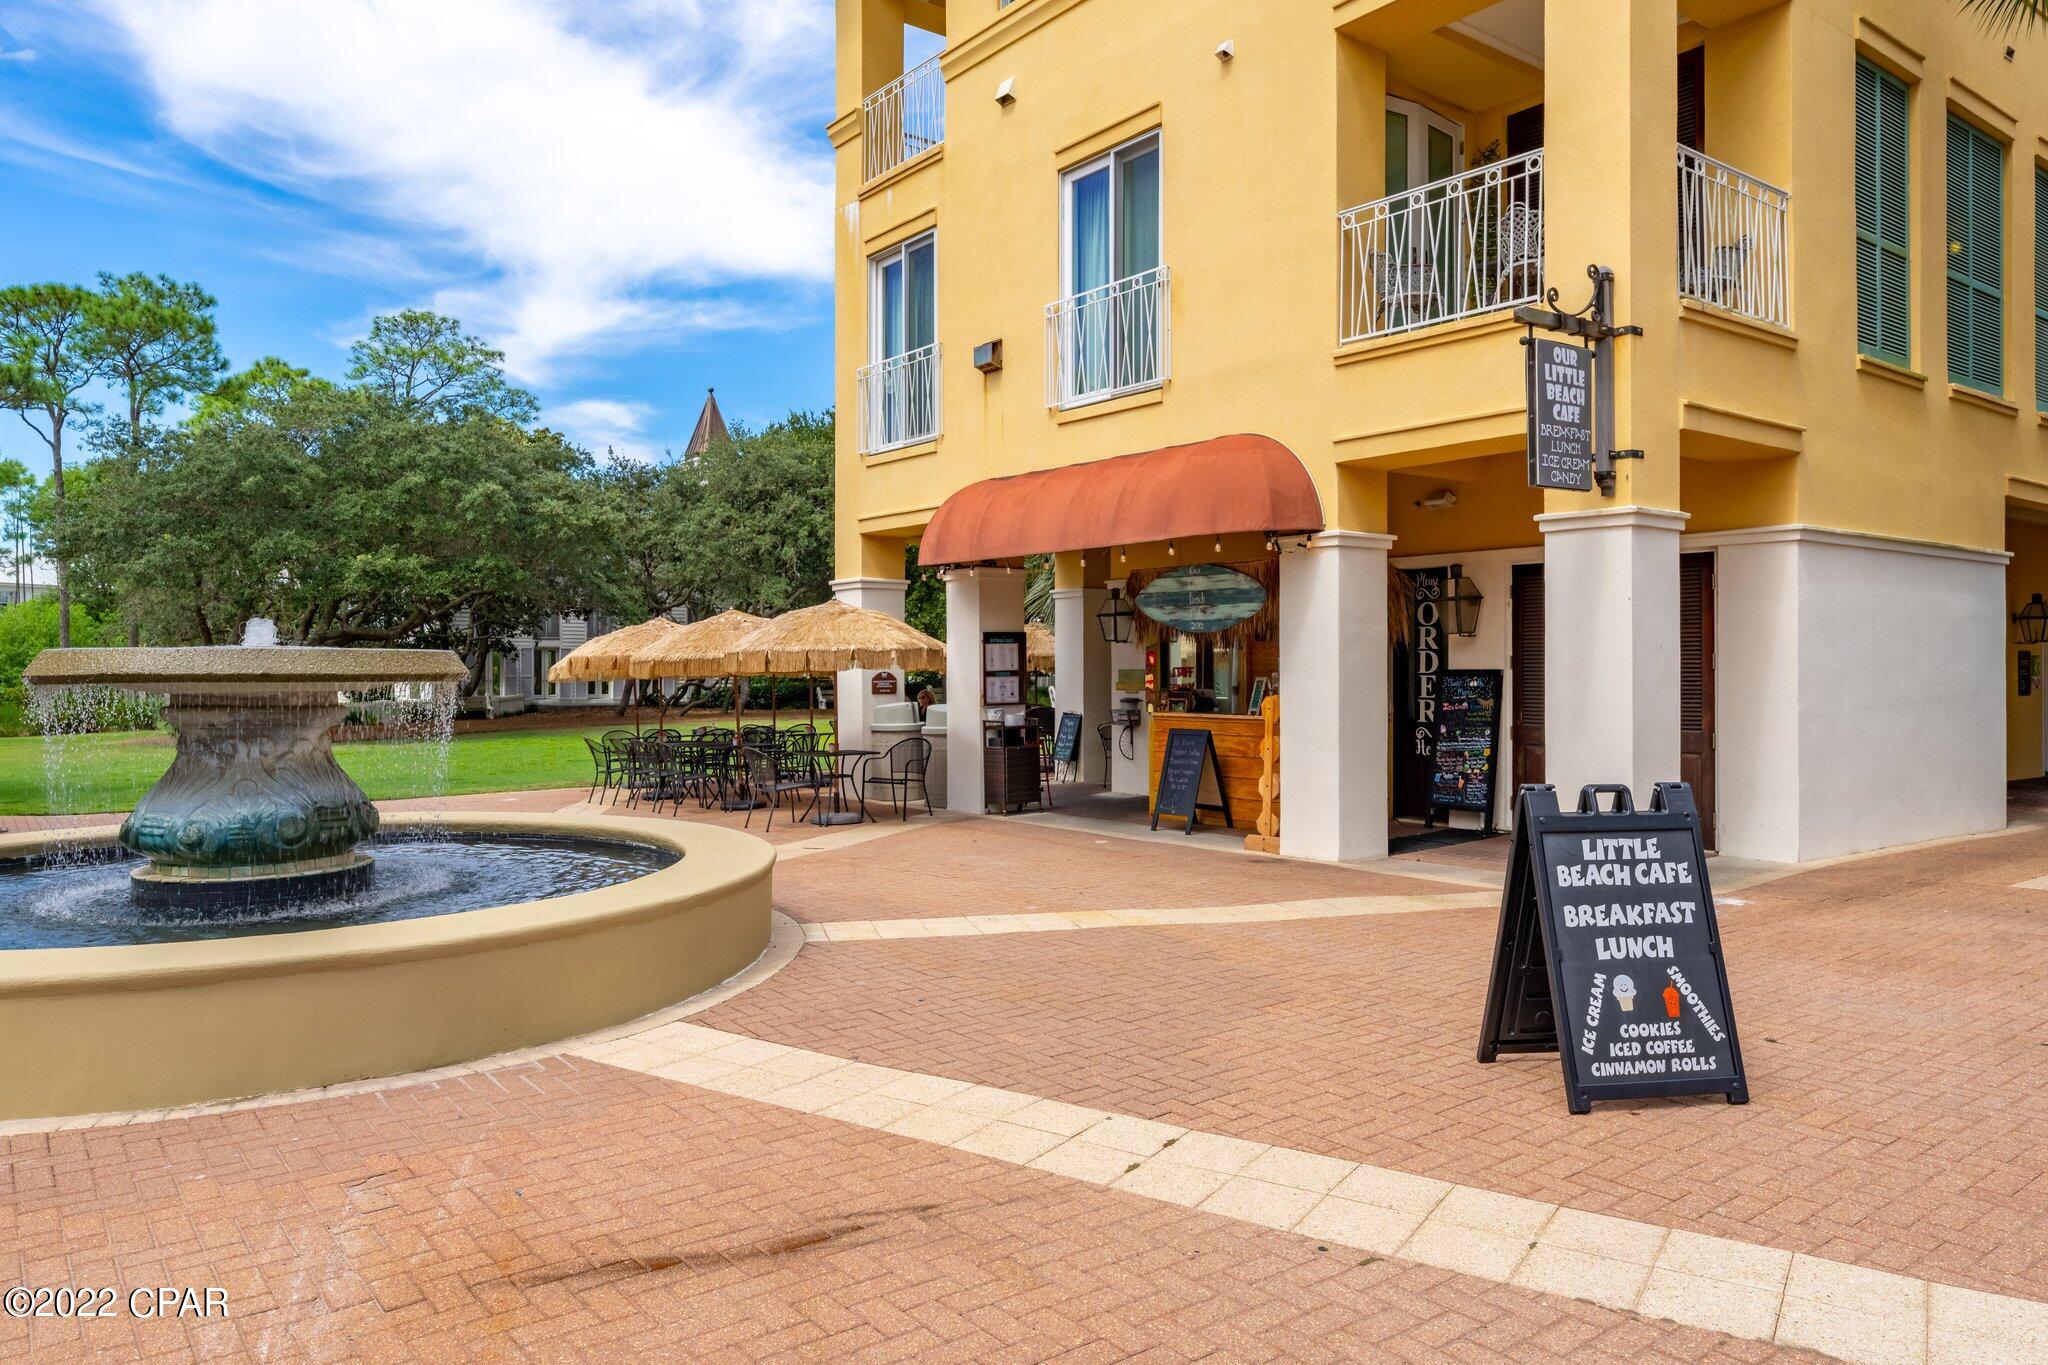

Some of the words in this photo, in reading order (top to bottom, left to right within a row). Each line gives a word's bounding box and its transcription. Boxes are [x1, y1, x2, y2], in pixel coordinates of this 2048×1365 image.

[1553, 346, 1578, 367] OUR
[1544, 363, 1585, 387] LITTLE
[1546, 383, 1585, 406] BEACH
[1552, 403, 1580, 424] CAFE
[1540, 423, 1591, 442] BREAKFAST
[1550, 440, 1581, 455] LUNCH
[1541, 453, 1560, 468] ICE
[1561, 456, 1590, 471] CREAM
[1550, 470, 1582, 485] CANDY
[1415, 572, 1439, 588] Please
[1416, 601, 1439, 723] ORDER
[1581, 837, 1661, 861] LITTLE
[1556, 863, 1632, 887] BEACH
[1635, 861, 1693, 885] CAFE
[1563, 901, 1696, 928] BREAKFAST
[1595, 935, 1675, 960] LUNCH
[1586, 972, 1607, 1028] CREAM
[1666, 965, 1726, 1042] SMOOTHIES
[1620, 1020, 1682, 1038] COOKIES
[1581, 1029, 1597, 1056] ICE
[1609, 1041, 1641, 1057] ICED
[1645, 1038, 1696, 1055] COFFEE
[1591, 1059, 1666, 1077] CINNAMON
[1671, 1055, 1717, 1073] ROLLS
